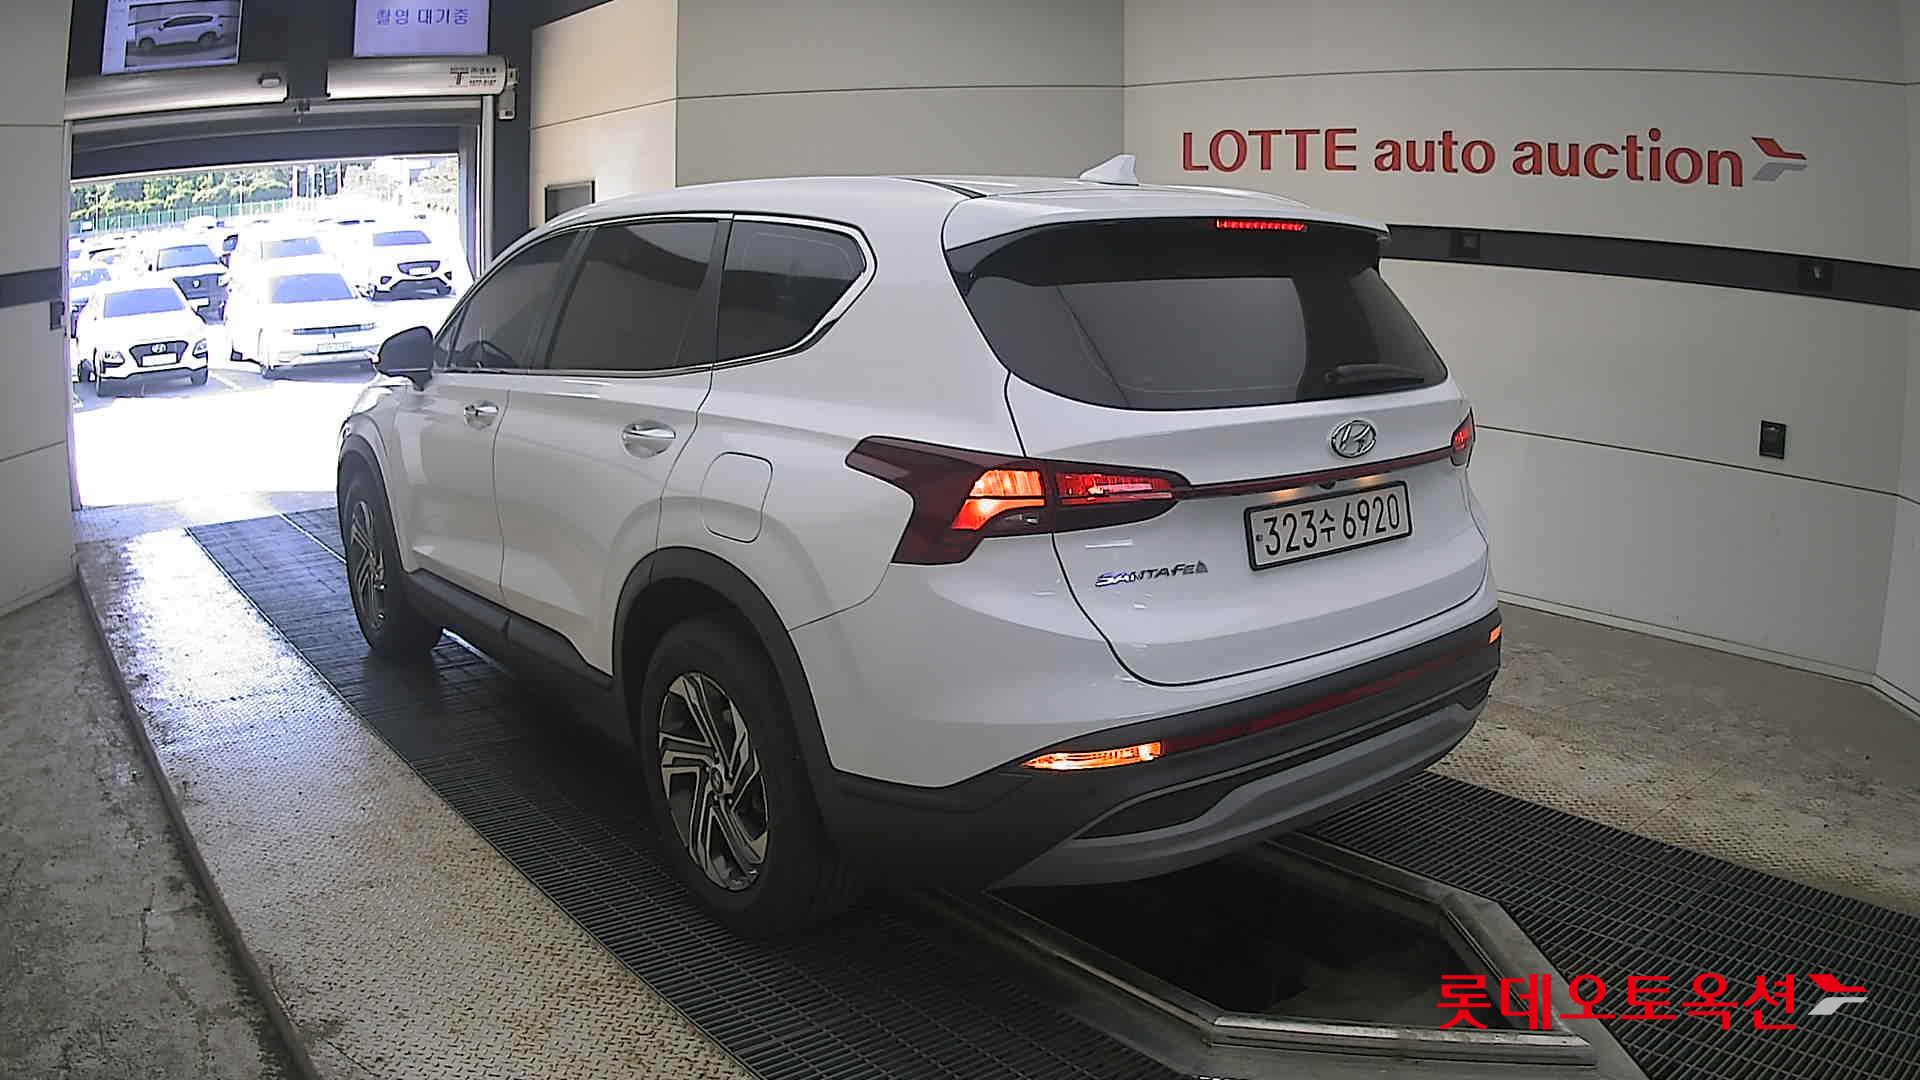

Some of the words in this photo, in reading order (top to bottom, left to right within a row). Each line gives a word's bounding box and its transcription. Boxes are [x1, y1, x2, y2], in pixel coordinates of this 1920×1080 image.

[417, 8, 469, 25] 대기중
[1183, 127, 1358, 173] LOTTE
[1373, 130, 1496, 174] auto
[1512, 127, 1744, 188] auction
